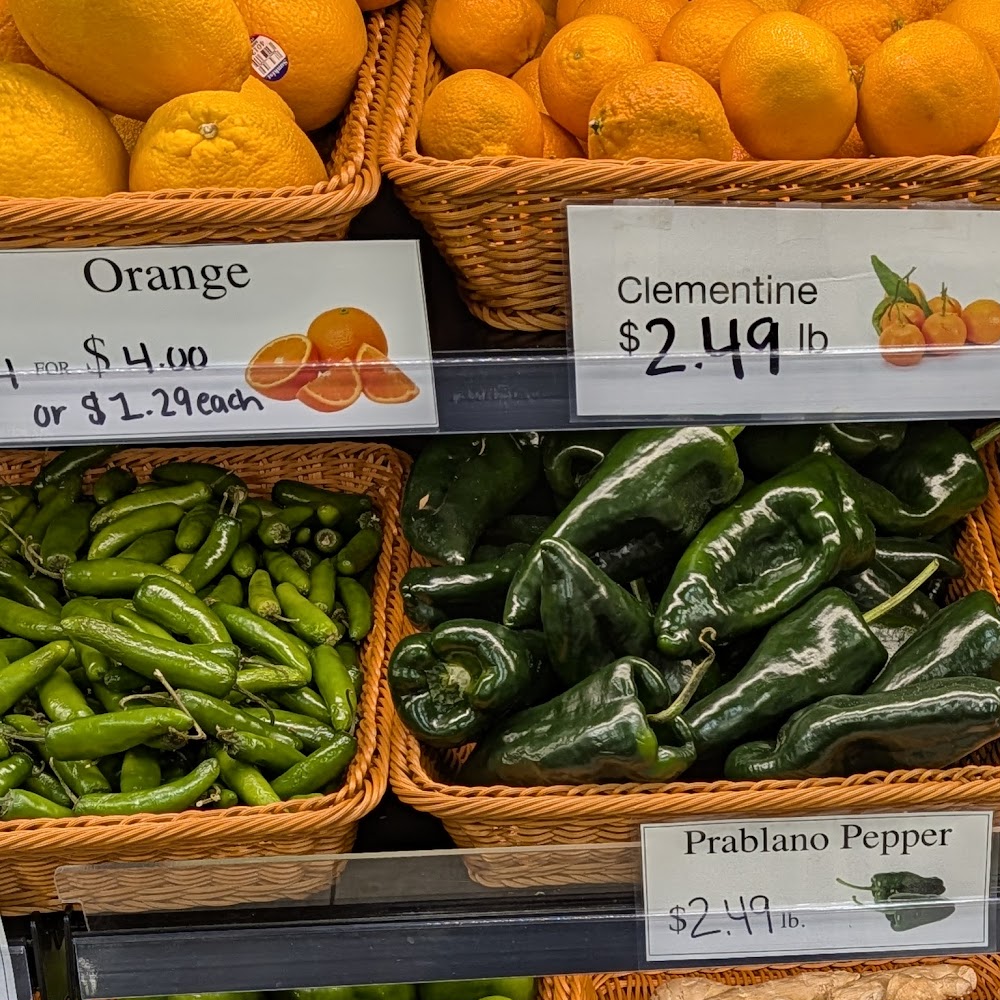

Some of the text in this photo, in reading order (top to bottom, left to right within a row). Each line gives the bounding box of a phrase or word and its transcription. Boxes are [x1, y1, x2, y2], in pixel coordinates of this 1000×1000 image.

[83, 257, 250, 300] Orange
[618, 275, 818, 305] Clementine
[619, 316, 828, 379] $2.49 lb
[34, 362, 69, 375] FOR
[33, 404, 67, 428] or
[683, 823, 953, 856] Prablano Pepper
[668, 895, 806, 939] $2.49 lb.
